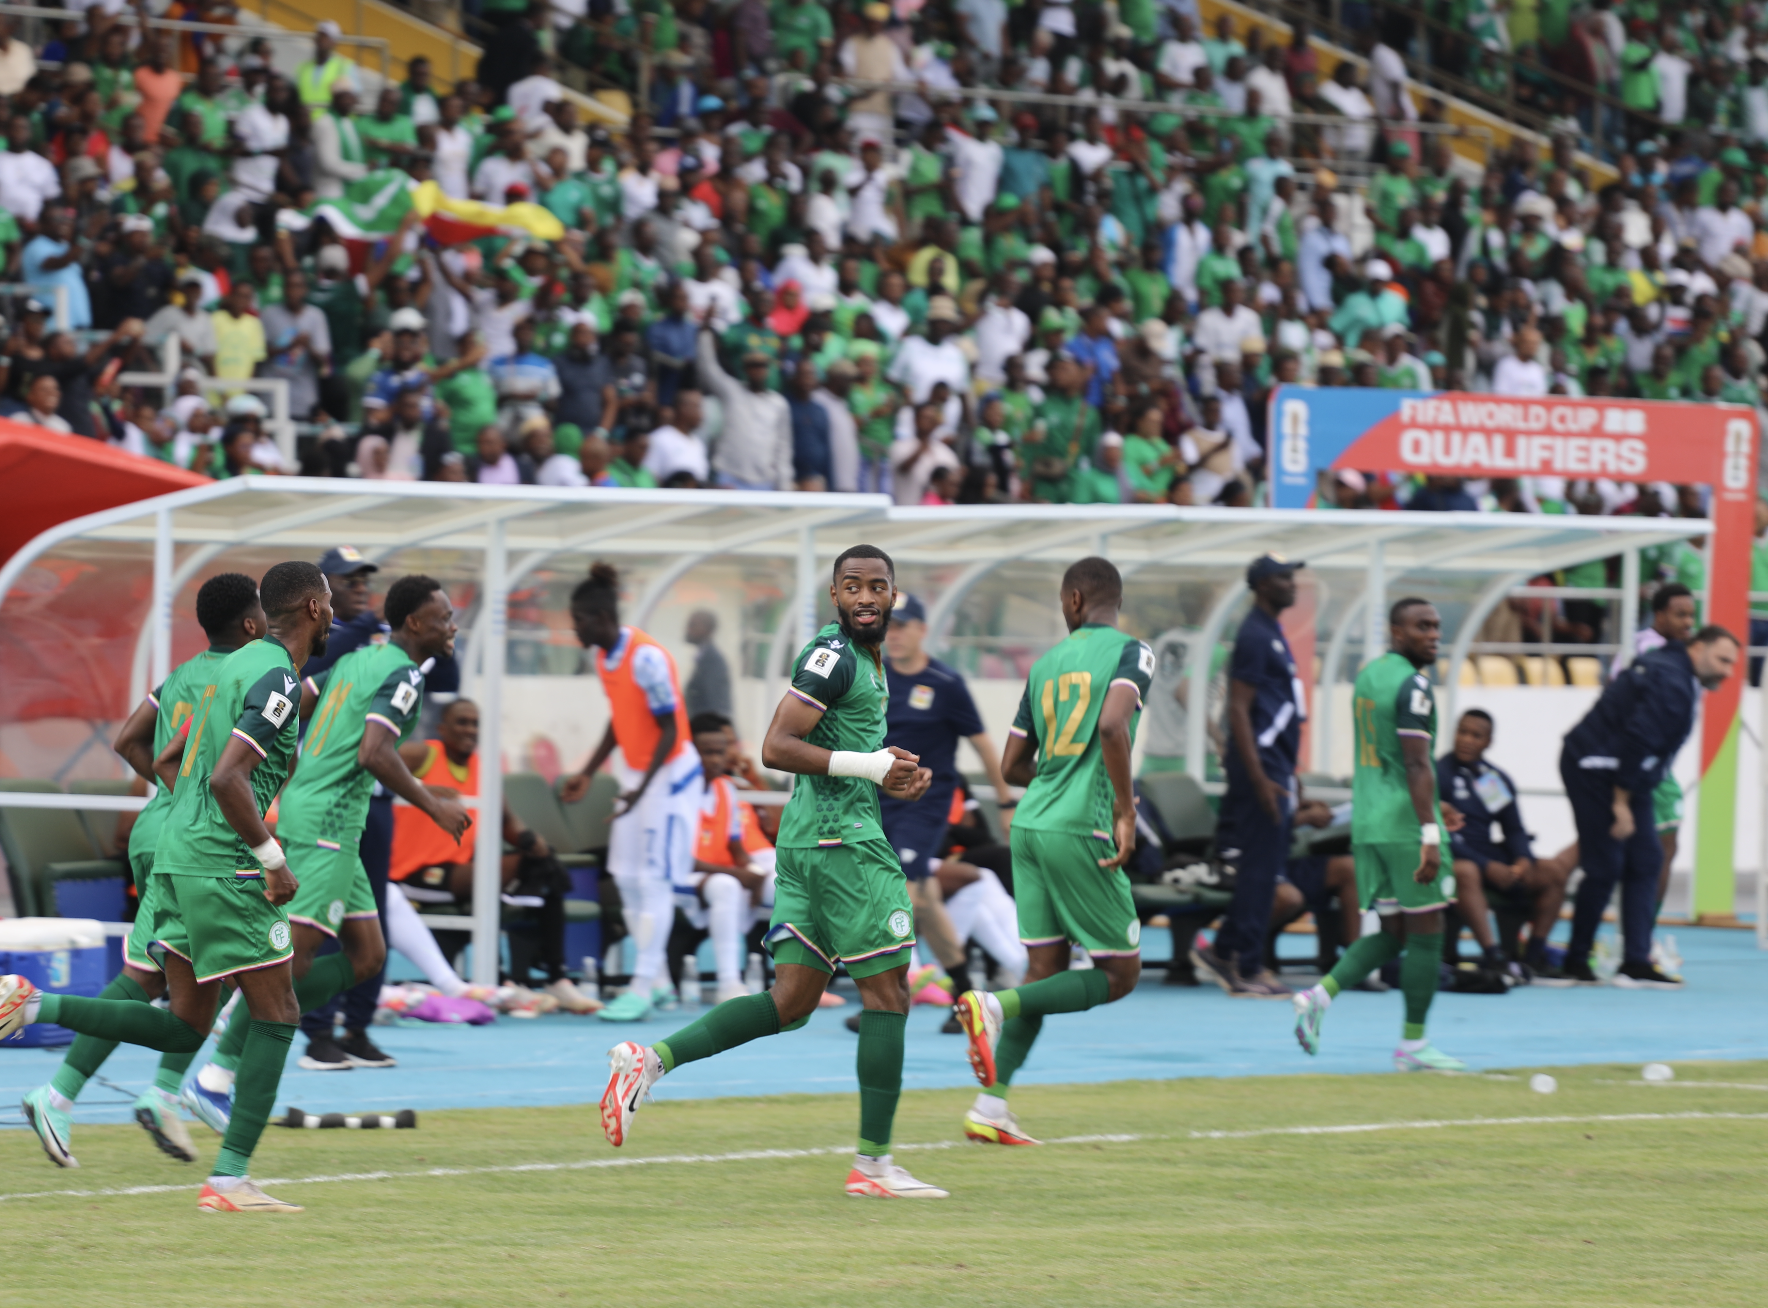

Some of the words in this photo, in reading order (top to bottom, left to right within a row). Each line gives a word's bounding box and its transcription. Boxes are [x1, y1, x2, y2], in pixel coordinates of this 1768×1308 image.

[1399, 427, 1649, 476] QUALIFIERS
[1400, 398, 1455, 427] FIFA
[1455, 401, 1548, 432] WORLD
[1549, 405, 1600, 434] CUP
[181, 685, 217, 777] 7
[304, 678, 353, 757] 11
[1041, 671, 1092, 761] 12
